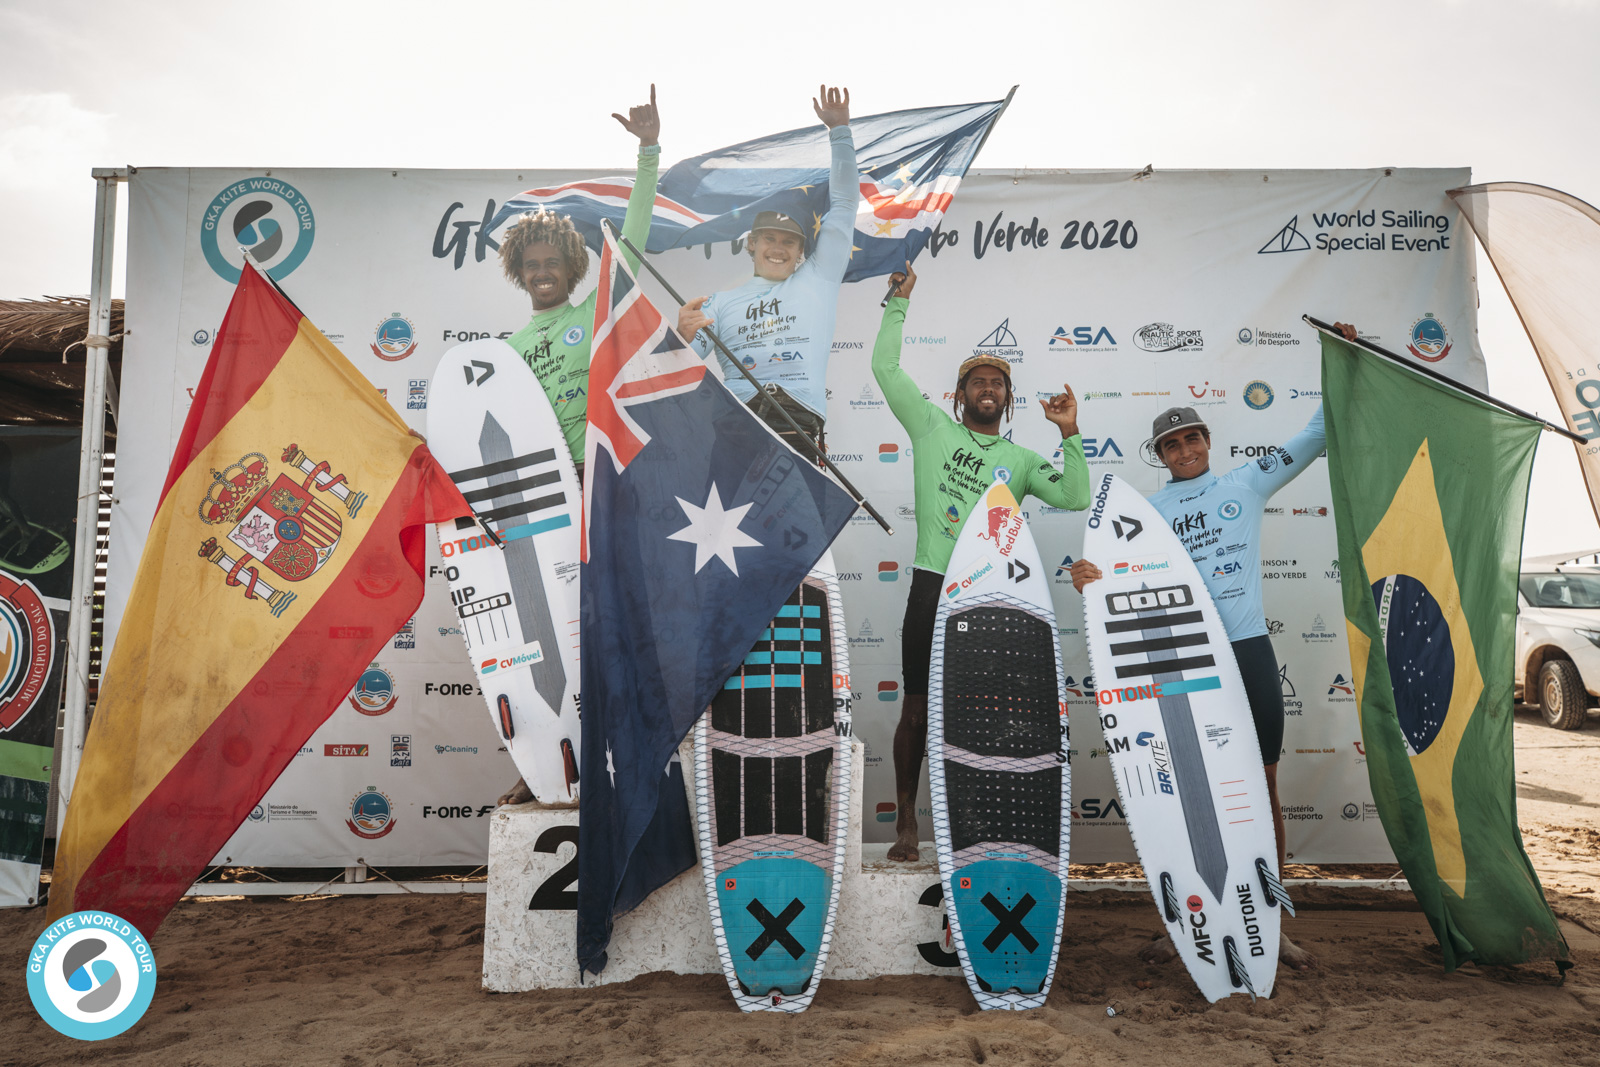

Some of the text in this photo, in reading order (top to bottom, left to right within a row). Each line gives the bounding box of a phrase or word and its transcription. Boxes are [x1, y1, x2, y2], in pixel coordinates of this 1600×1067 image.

[205, 180, 312, 231] GKA KITE WORLD TOUR
[1312, 210, 1449, 232] World Sailing
[433, 199, 512, 270] GK
[974, 211, 1049, 259] Verde
[1060, 219, 1138, 250] 2020
[1315, 233, 1450, 255] Special Event
[746, 298, 782, 321] GKA
[919, 336, 947, 345] Móvel
[1049, 326, 1117, 345] ASA
[1144, 330, 1202, 338] NAUTIC SPORT
[1144, 337, 1204, 348] EVENTOS
[1259, 331, 1292, 339] Ministério
[1267, 339, 1300, 347] Desporto
[768, 351, 804, 362] ASA
[998, 349, 1024, 357] Sailing
[952, 448, 985, 475] GKA
[1230, 446, 1277, 457] F-one
[1088, 473, 1114, 530] Ortobom
[1173, 511, 1207, 536] GKA
[441, 529, 508, 557] OTONE
[1000, 516, 1024, 557] Red Bull
[1131, 560, 1170, 573] CVMóvel
[1212, 561, 1242, 577] ASA
[21, 605, 47, 702] MUNICÍPIO DO SAL
[500, 649, 542, 669] CVMóvel
[425, 683, 473, 695] F-one
[1150, 739, 1174, 795] BRKITE
[423, 805, 473, 818] F-one
[1288, 813, 1323, 821] Desporto
[528, 825, 580, 910] 2
[1237, 883, 1265, 957] DUOTONE
[1190, 911, 1216, 966] MFC
